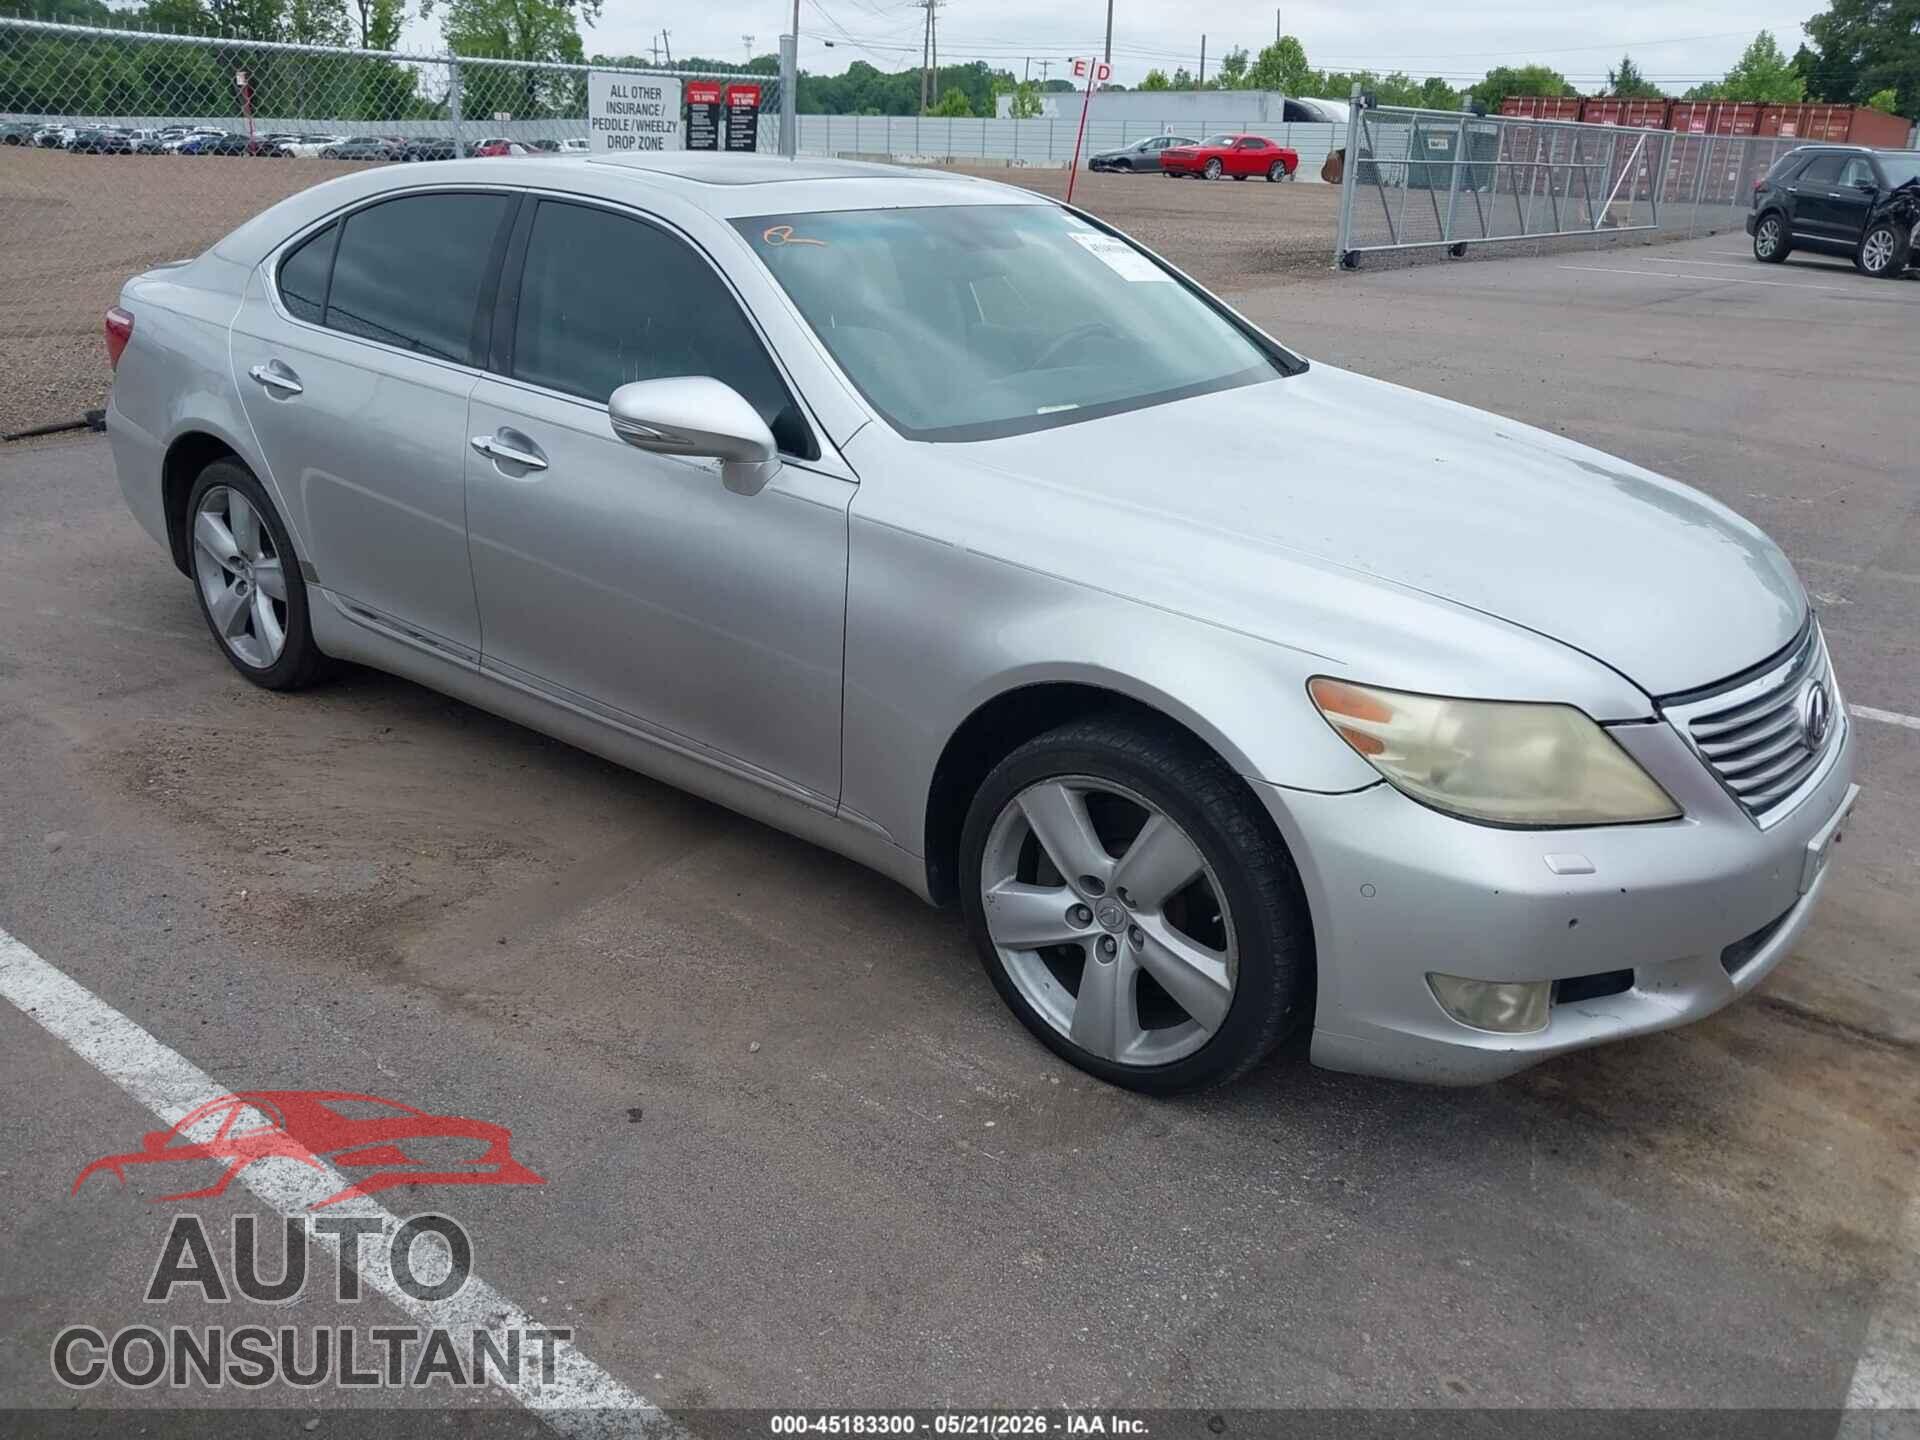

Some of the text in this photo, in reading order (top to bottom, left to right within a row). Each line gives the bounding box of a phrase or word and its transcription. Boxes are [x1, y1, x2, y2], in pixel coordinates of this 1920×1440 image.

[1074, 61, 1086, 77] E
[1098, 65, 1110, 80] D
[610, 84, 662, 100] ALL OTHER
[607, 135, 664, 151] DROP ZONE
